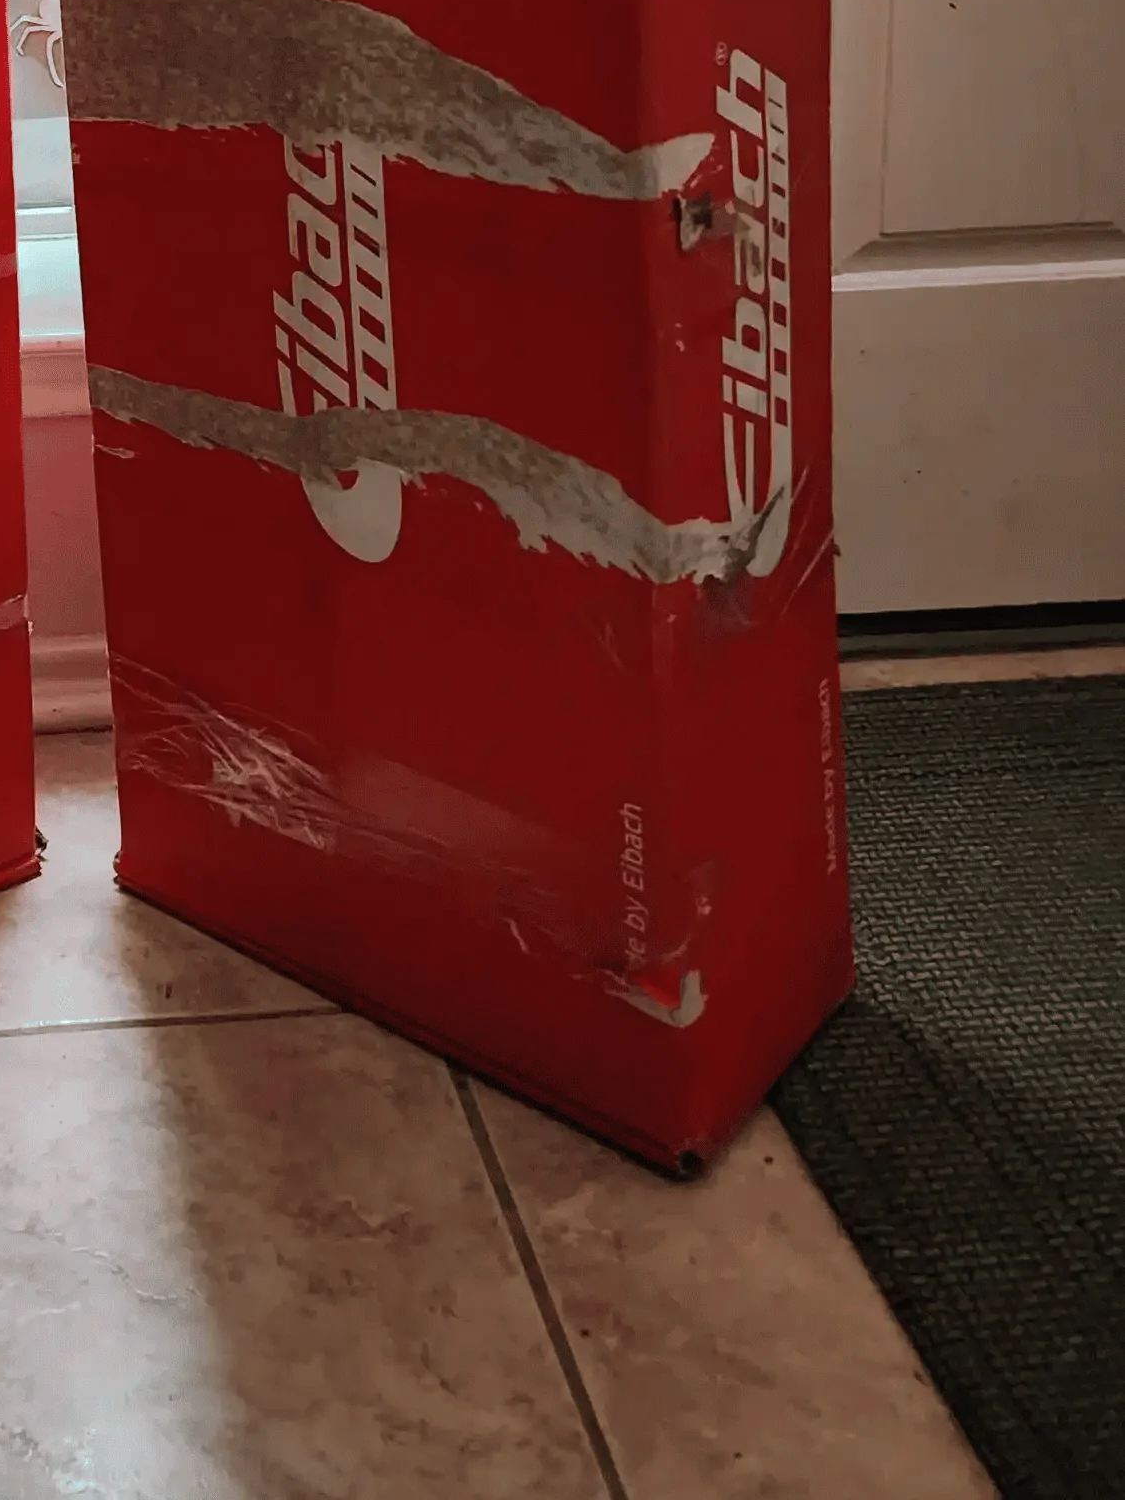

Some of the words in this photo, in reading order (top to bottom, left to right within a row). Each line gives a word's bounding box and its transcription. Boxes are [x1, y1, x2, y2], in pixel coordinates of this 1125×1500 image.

[272, 130, 403, 564] Eibac
[715, 49, 793, 578] Eibach
[617, 802, 646, 892] Eibach
[622, 895, 650, 933] by
